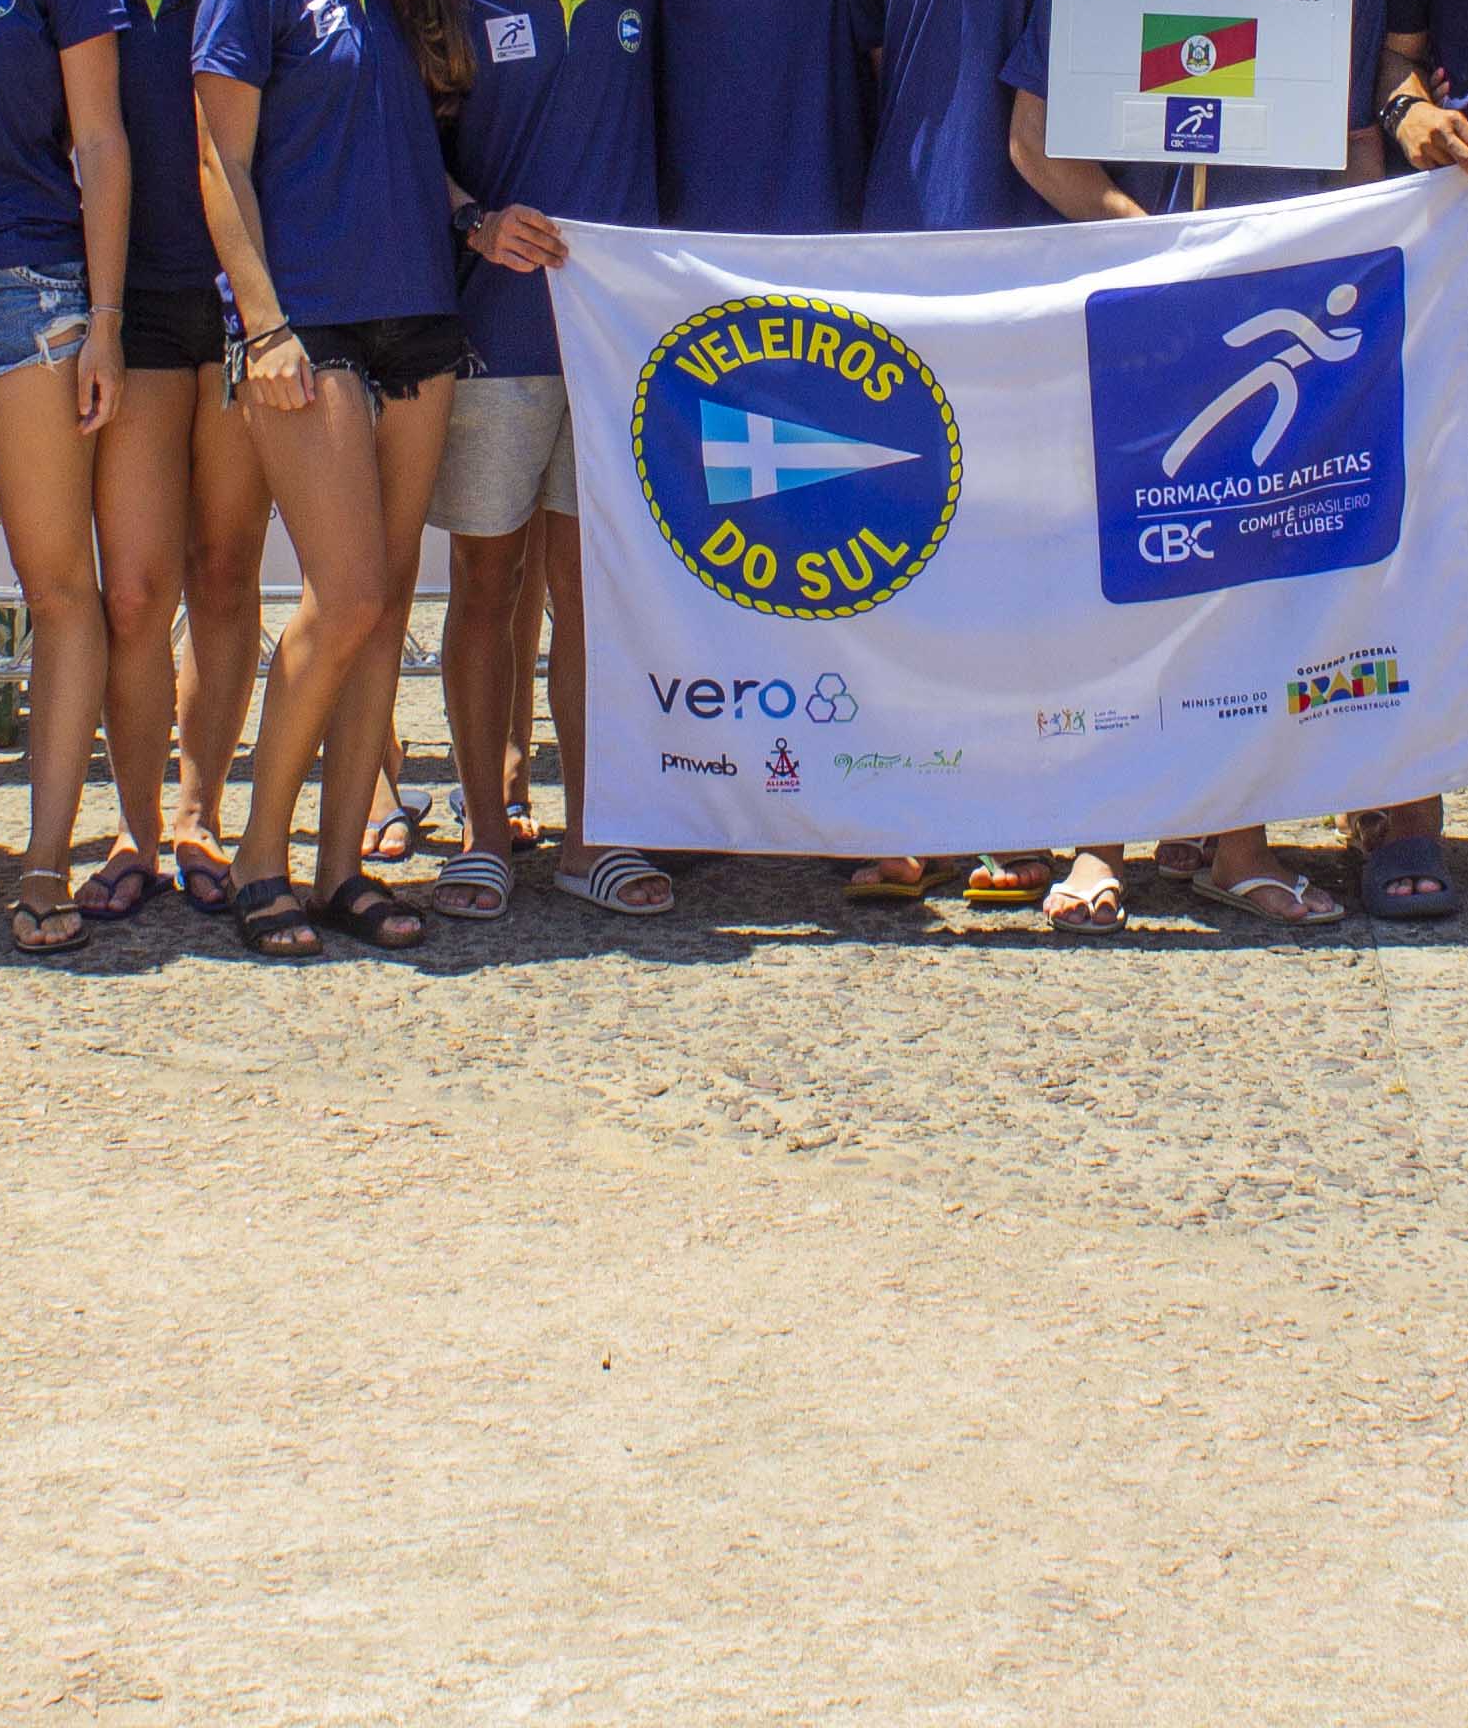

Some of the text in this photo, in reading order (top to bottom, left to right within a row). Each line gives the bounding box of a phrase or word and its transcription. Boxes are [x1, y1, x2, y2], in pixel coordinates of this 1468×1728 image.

[675, 318, 904, 401] VELEIROS
[1136, 451, 1371, 508] FORMAÇÃO DE ATLETAS
[1239, 493, 1371, 534] COMITÊ BRASILEIRO
[1284, 515, 1345, 537] CLUBES
[700, 519, 909, 600] DO SUL
[1139, 520, 1215, 563] CBC
[1296, 645, 1397, 676] GOVERNO FEDERAL
[648, 672, 796, 719] vero
[1182, 691, 1268, 709] MINISTÉRIO DO
[1287, 659, 1410, 714] BRASIL
[1333, 699, 1401, 714] RECONSTRUÇÃO
[1218, 705, 1268, 719] ESPORTE
[661, 751, 737, 778] pmweb
